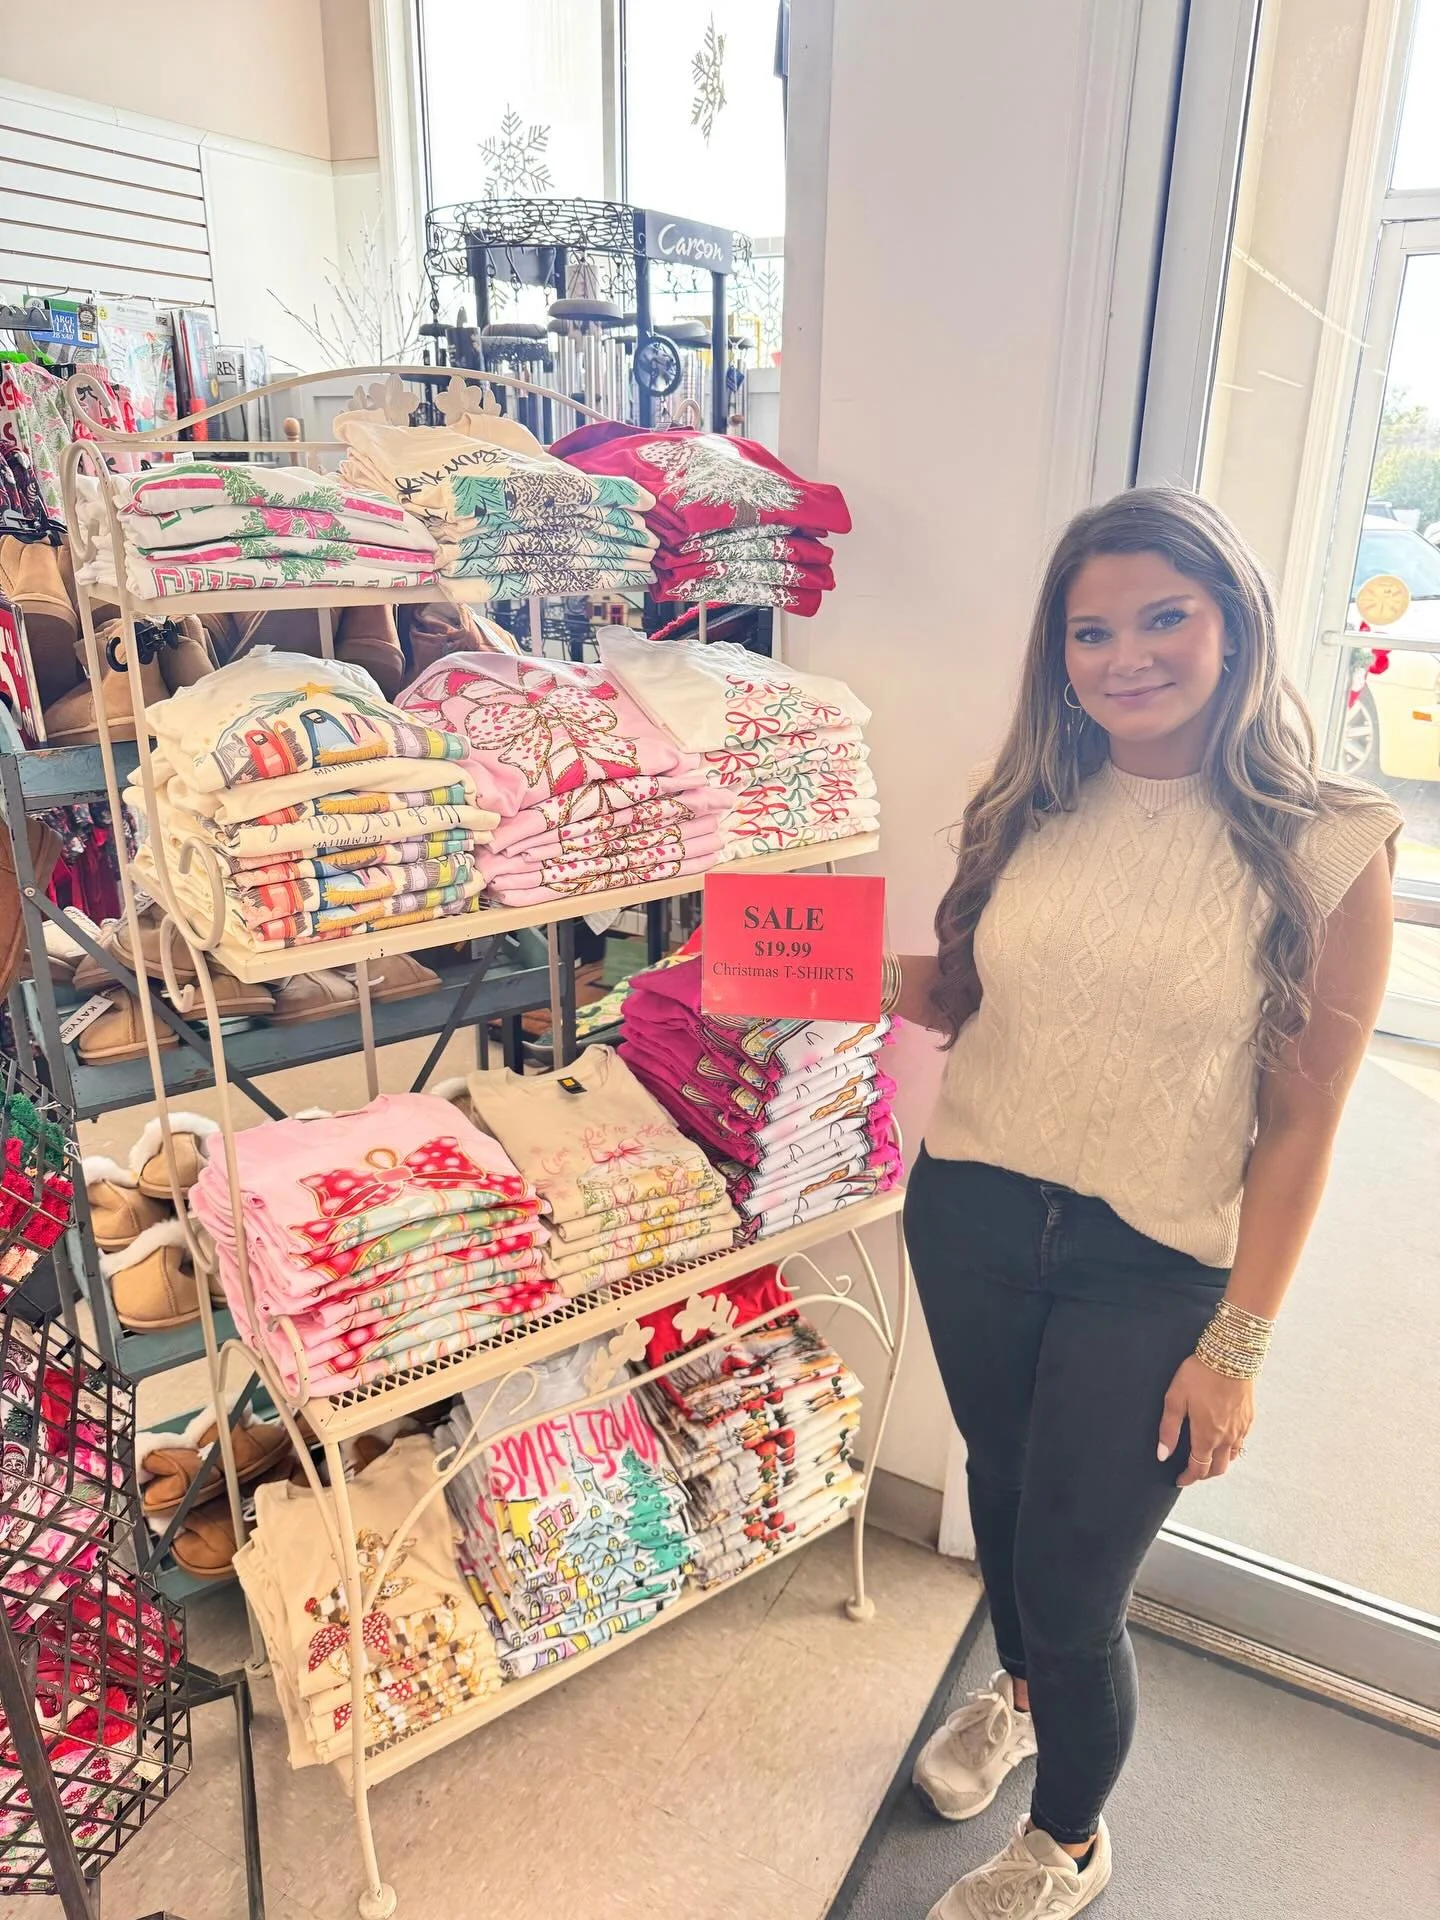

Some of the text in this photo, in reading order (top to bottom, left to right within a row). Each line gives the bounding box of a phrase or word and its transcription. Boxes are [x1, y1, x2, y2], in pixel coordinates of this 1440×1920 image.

[657, 223, 724, 262] Carson
[744, 905, 824, 931] SALE
[754, 939, 812, 960] $19.99
[712, 960, 855, 981] Christmas T-SHIRTS
